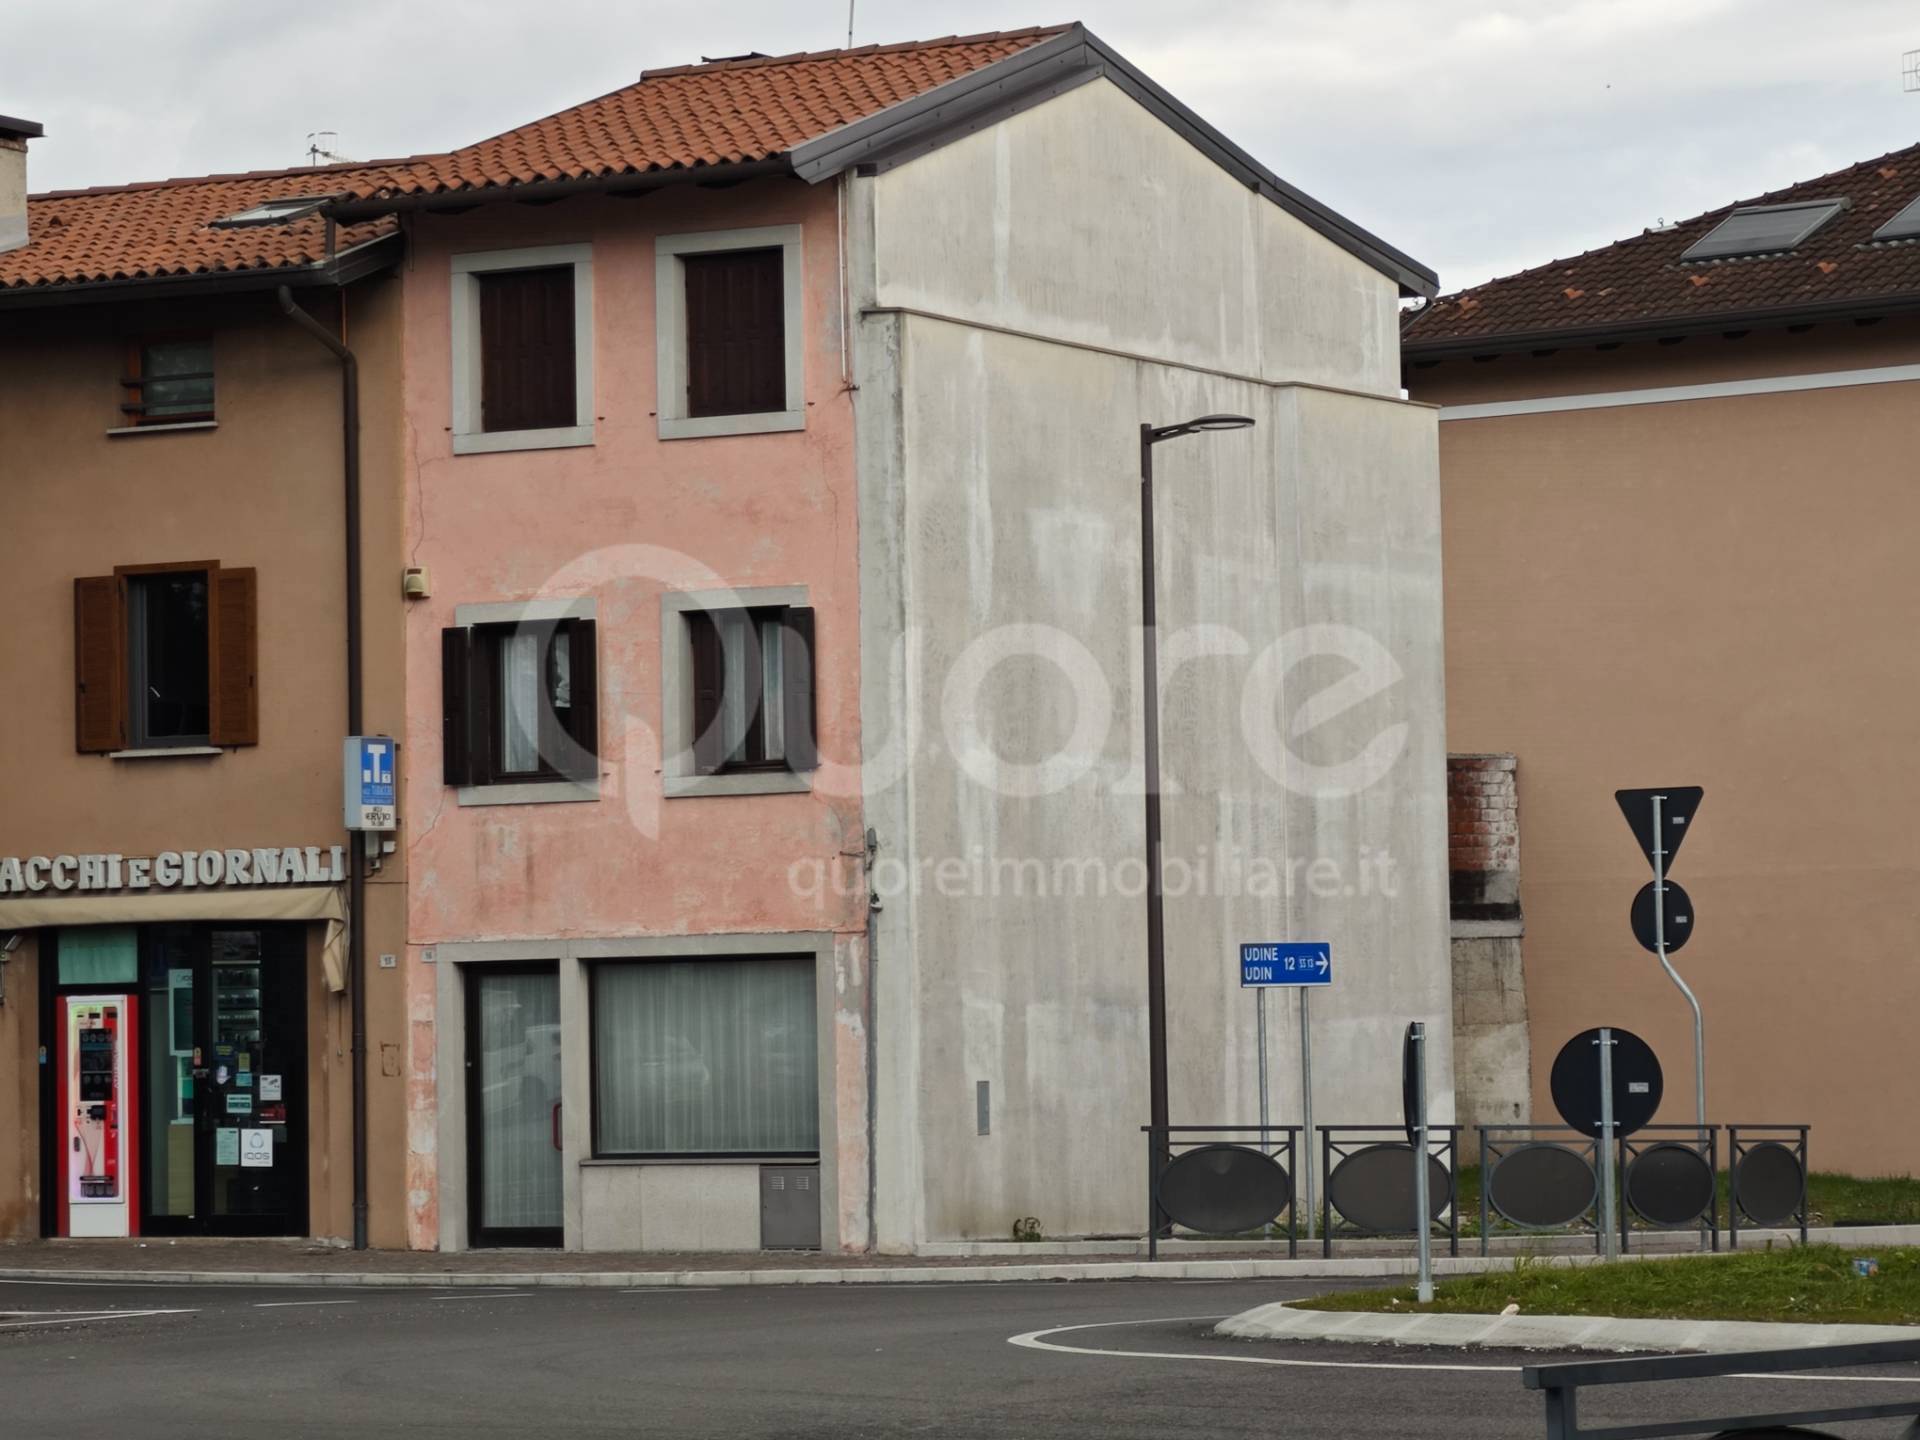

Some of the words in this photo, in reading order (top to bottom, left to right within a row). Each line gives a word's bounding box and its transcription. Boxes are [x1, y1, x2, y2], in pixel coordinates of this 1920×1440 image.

[155, 845, 346, 887] GIORNALI
[1244, 947, 1279, 962] UDINE
[1284, 956, 1295, 970] 12
[1245, 966, 1273, 981] UDIN
[244, 1152, 270, 1160] IQOS
